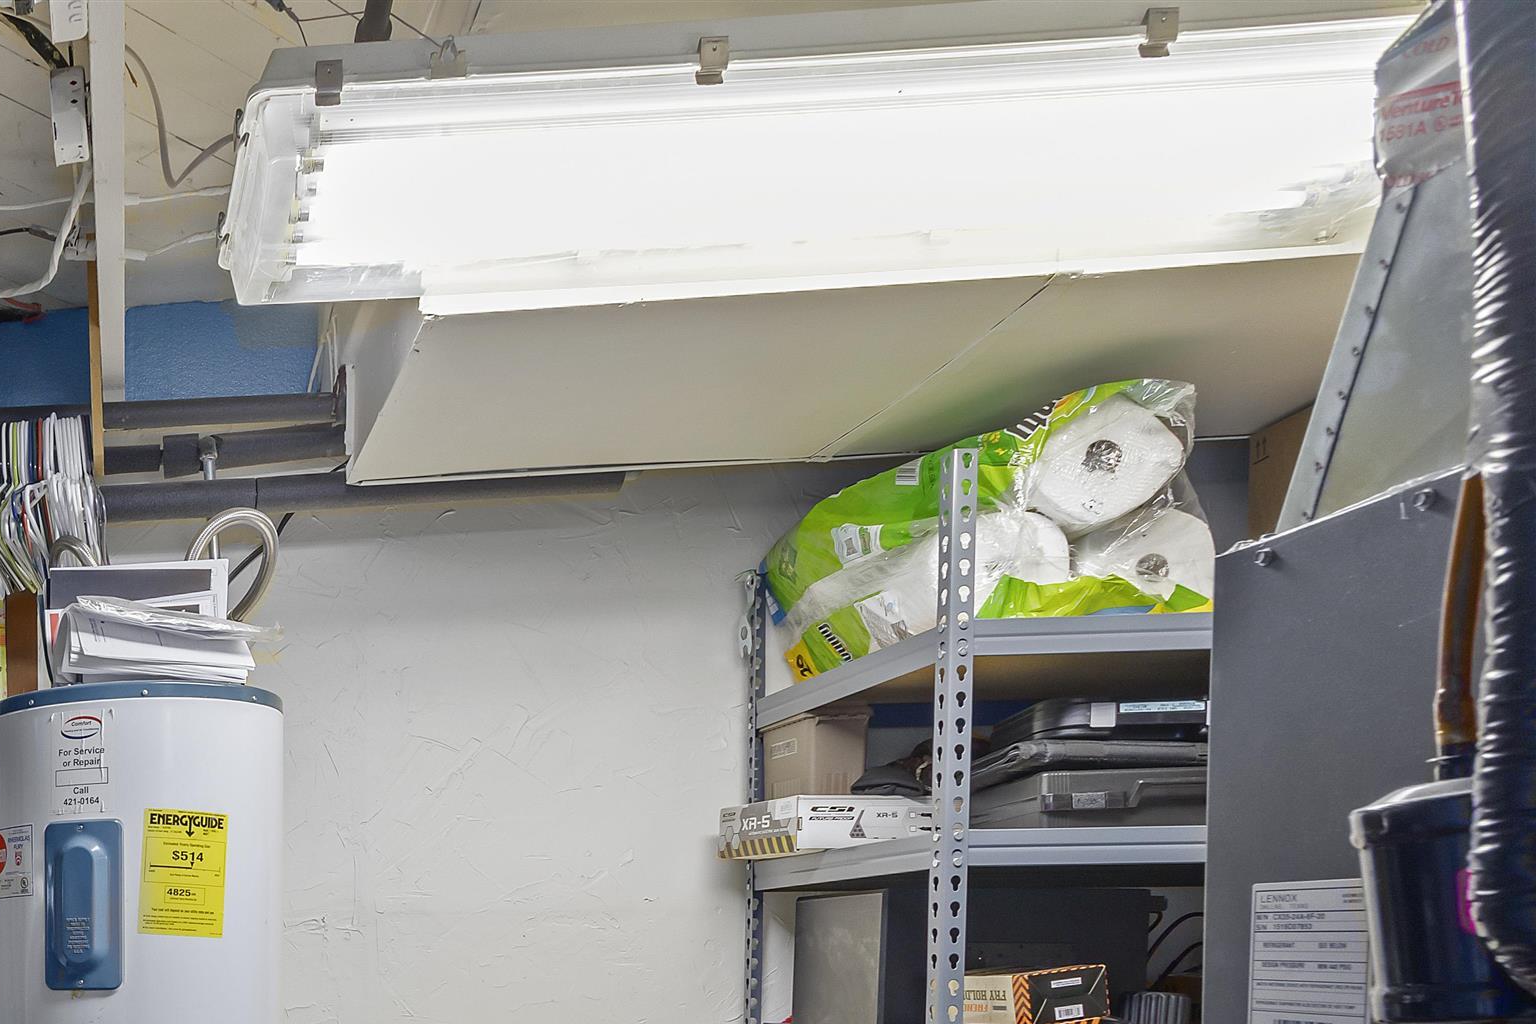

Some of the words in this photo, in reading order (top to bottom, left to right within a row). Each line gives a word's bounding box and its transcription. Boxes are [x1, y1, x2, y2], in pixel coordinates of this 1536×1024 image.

[58, 749, 72, 757] For
[73, 746, 105, 756] Service
[73, 758, 101, 767] Repair
[73, 786, 89, 794] Call
[63, 797, 100, 805] 421-0164
[149, 812, 224, 830] ENERGYGUIDE
[172, 850, 204, 862] $514
[166, 888, 191, 897] 4825
[1261, 893, 1298, 904] LENNOX
[990, 989, 1007, 1001] FRY
